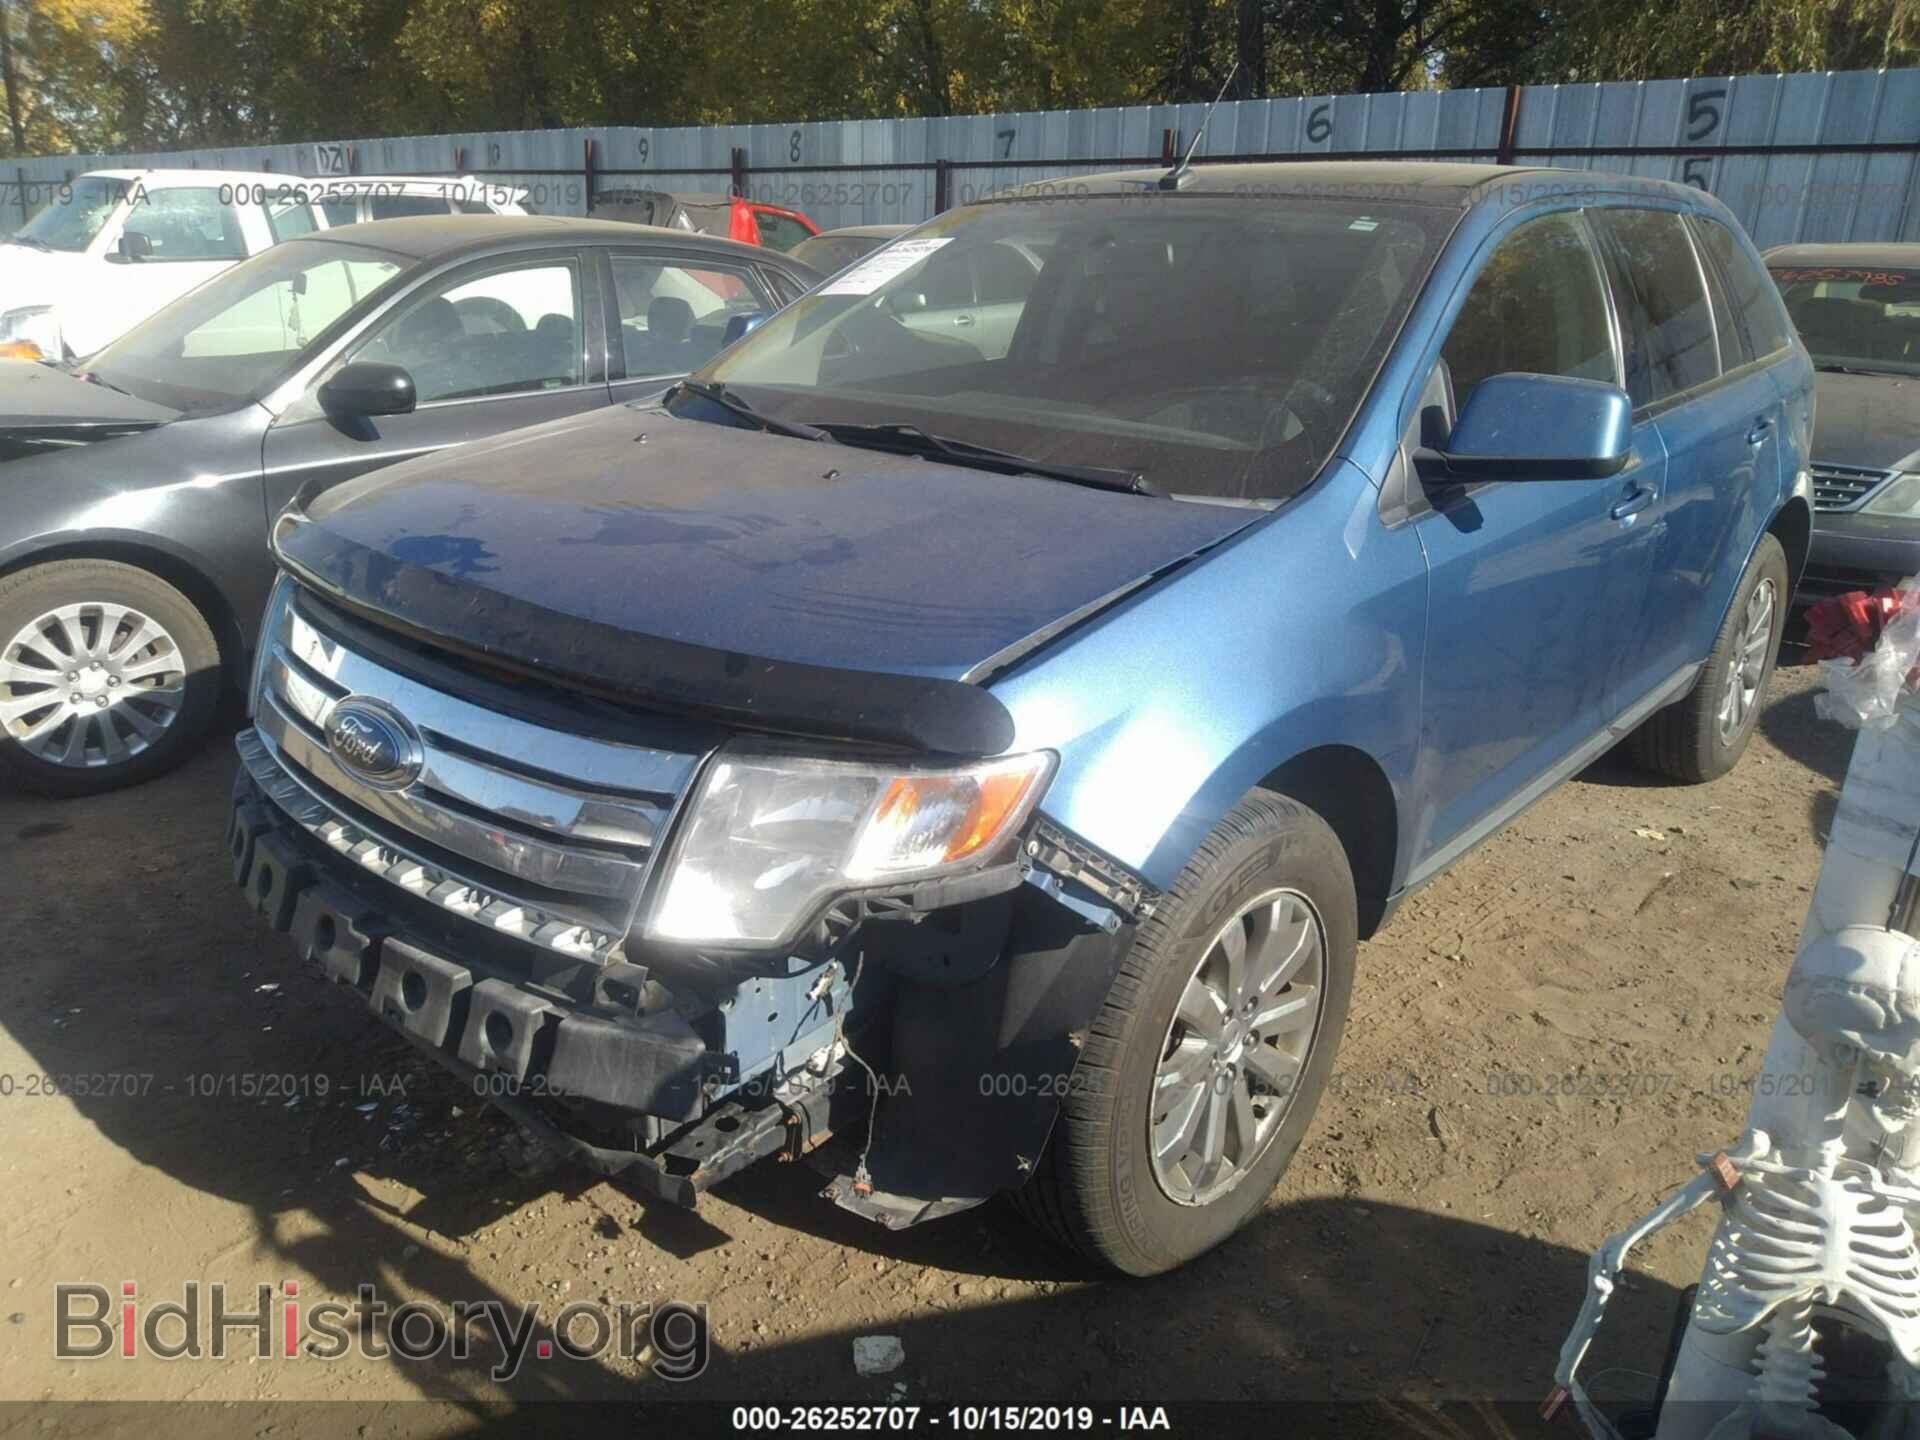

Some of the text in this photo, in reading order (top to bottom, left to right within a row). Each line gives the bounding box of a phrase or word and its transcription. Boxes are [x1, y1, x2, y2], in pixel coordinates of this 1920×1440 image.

[1306, 104, 1332, 143] 6
[1687, 90, 1726, 141] 5
[638, 137, 650, 165] 9
[790, 129, 801, 162] 8
[997, 128, 1016, 159] 7
[335, 716, 383, 764] Ford
